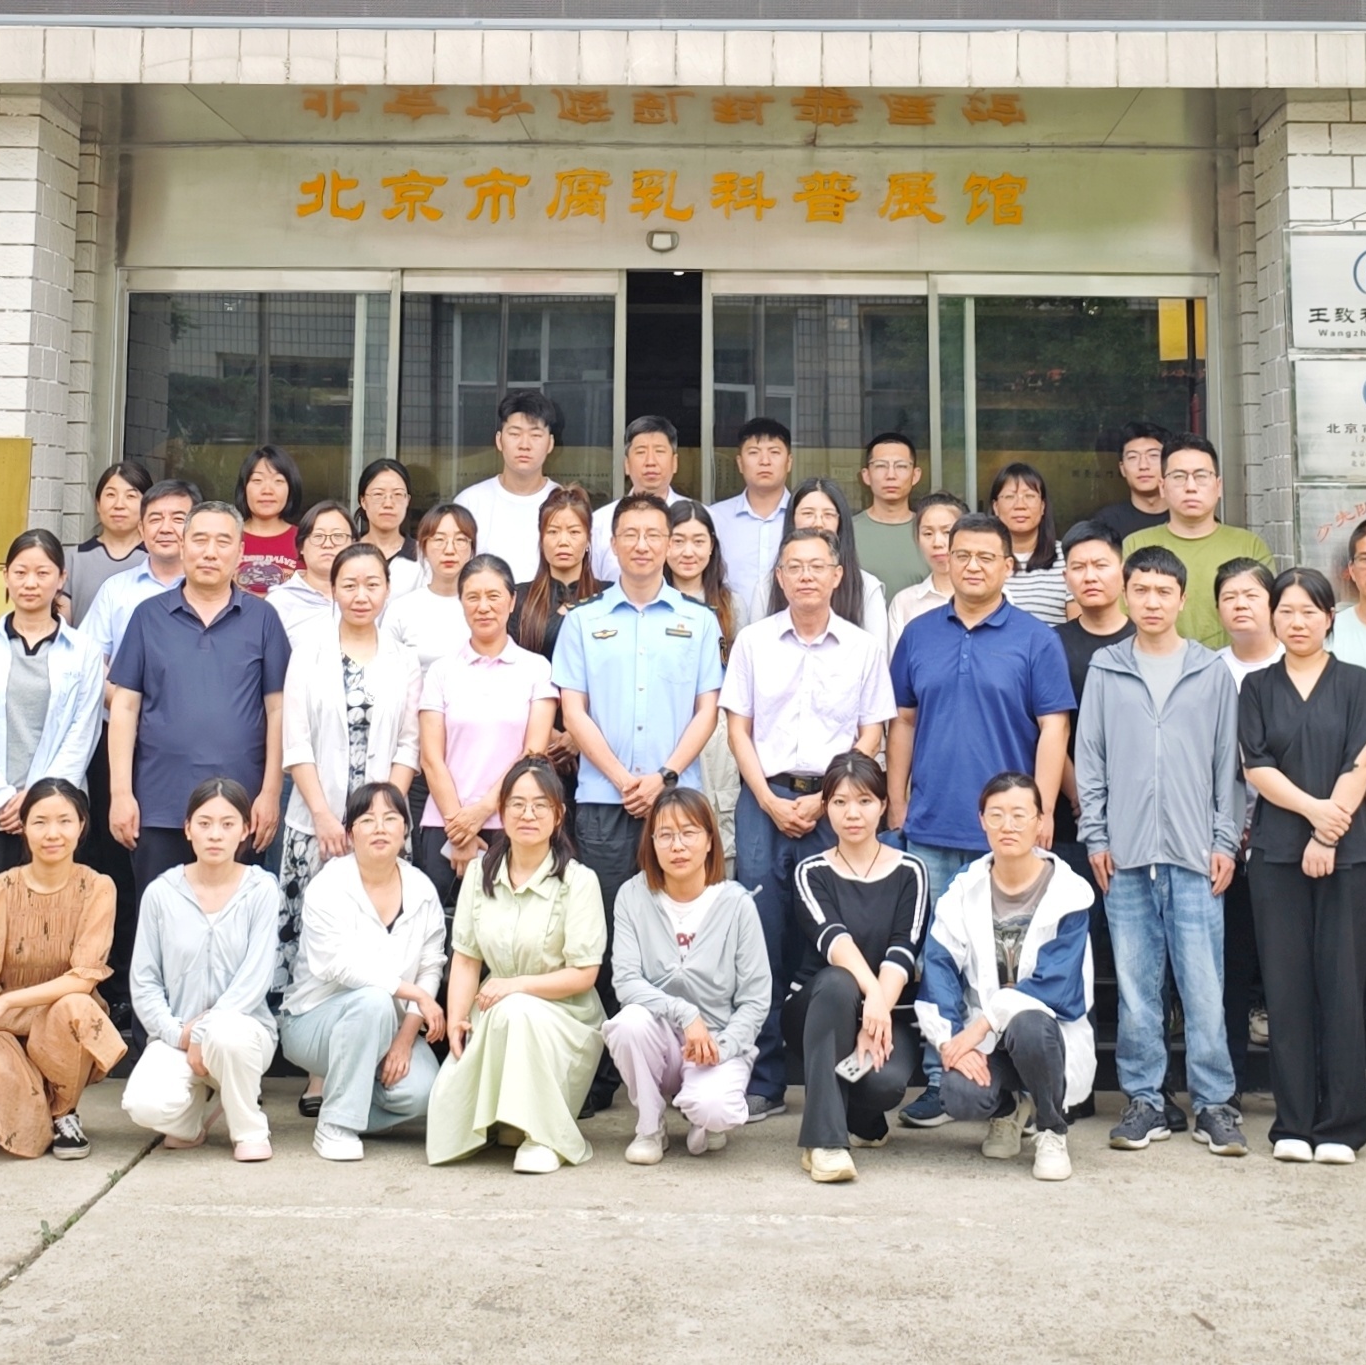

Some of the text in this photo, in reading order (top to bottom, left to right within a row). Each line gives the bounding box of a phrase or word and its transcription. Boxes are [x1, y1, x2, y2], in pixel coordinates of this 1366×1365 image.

[296, 166, 1029, 226] 北京市腐乳科普展馆
